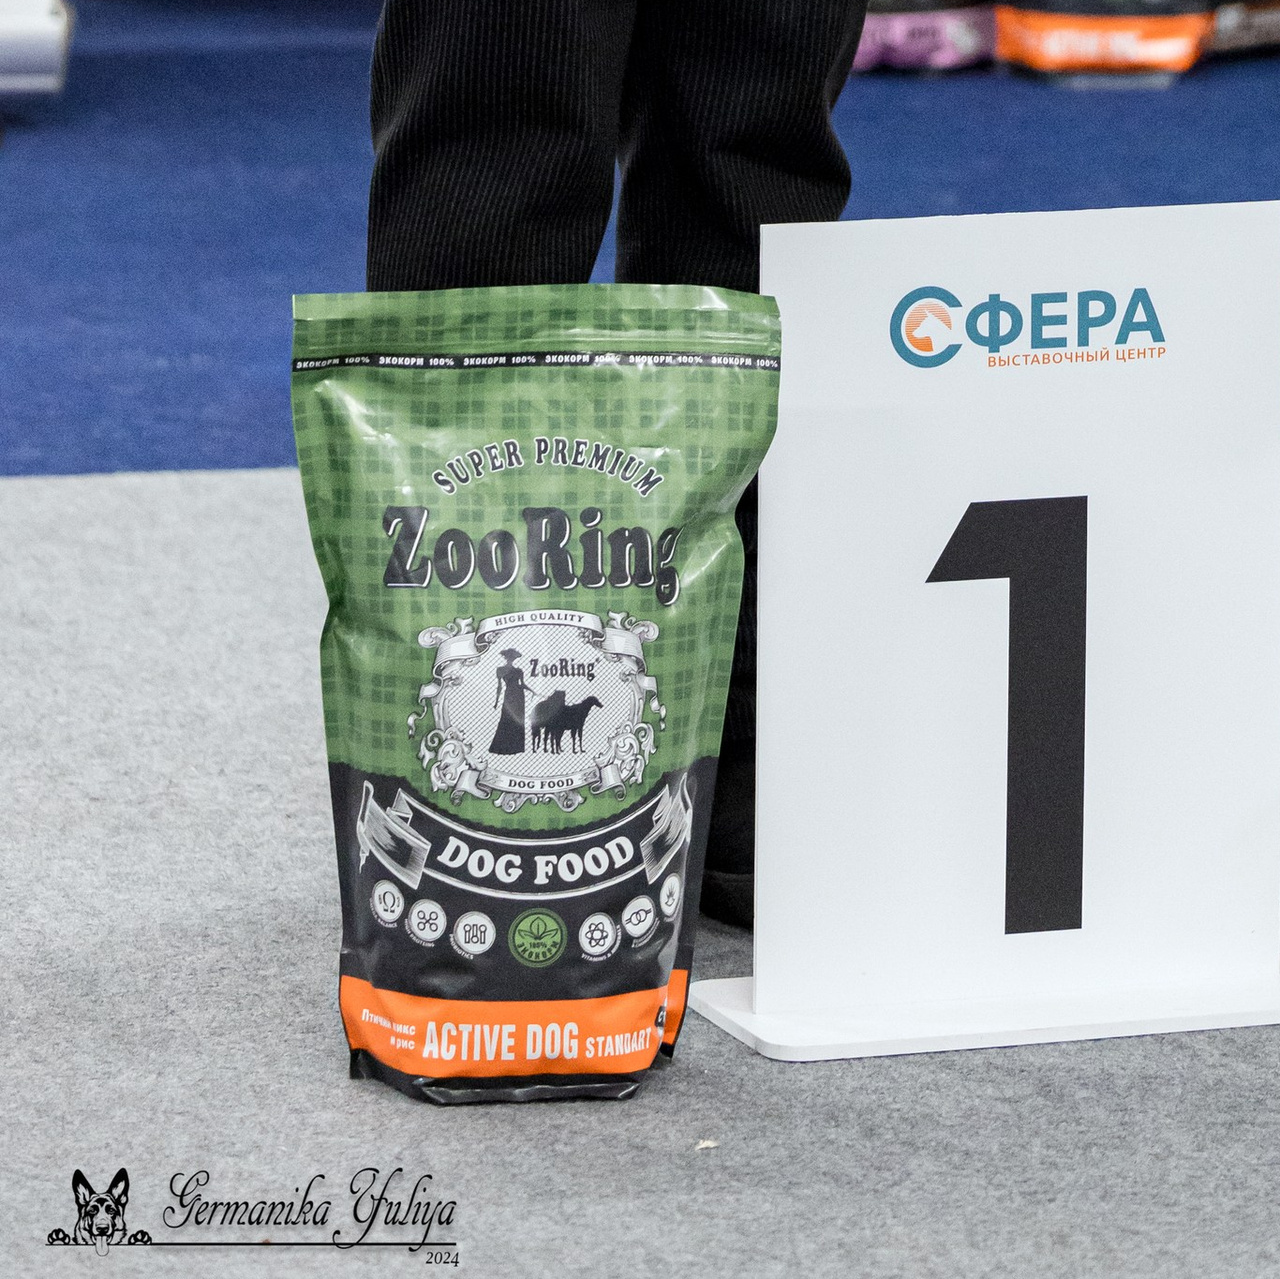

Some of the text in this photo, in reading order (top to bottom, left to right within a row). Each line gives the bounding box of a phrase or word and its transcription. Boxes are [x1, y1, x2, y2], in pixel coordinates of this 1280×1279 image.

[889, 285, 1167, 369] СФЕРА
[296, 357, 340, 369] ЭКОКОРМ
[345, 355, 370, 365] 100%
[379, 356, 424, 366] ЭКОКОРМ
[429, 357, 455, 367] 100%
[463, 356, 506, 366] ЭКОКОРМ
[511, 355, 537, 364] 100%
[545, 354, 590, 363] ЭКОКОРМ
[629, 354, 673, 364] ЭКОКОРМ
[677, 355, 703, 364] 100%
[711, 356, 752, 366] ЭКОКОРМ
[756, 359, 778, 368] 100%
[987, 346, 1167, 368] ВЫСТАВОЧНЫЙ ЦЕНТР
[432, 436, 665, 497] SUPER PREMIUM
[382, 505, 684, 606] ZooRing
[494, 612, 585, 627] HIGH QUALITY
[925, 495, 1088, 935] 1
[508, 777, 574, 789] DOG FOOD
[437, 835, 634, 885] DOG FOOD
[396, 1038, 415, 1050] рис
[422, 1021, 652, 1062] ACTIVE DOG STANDART
